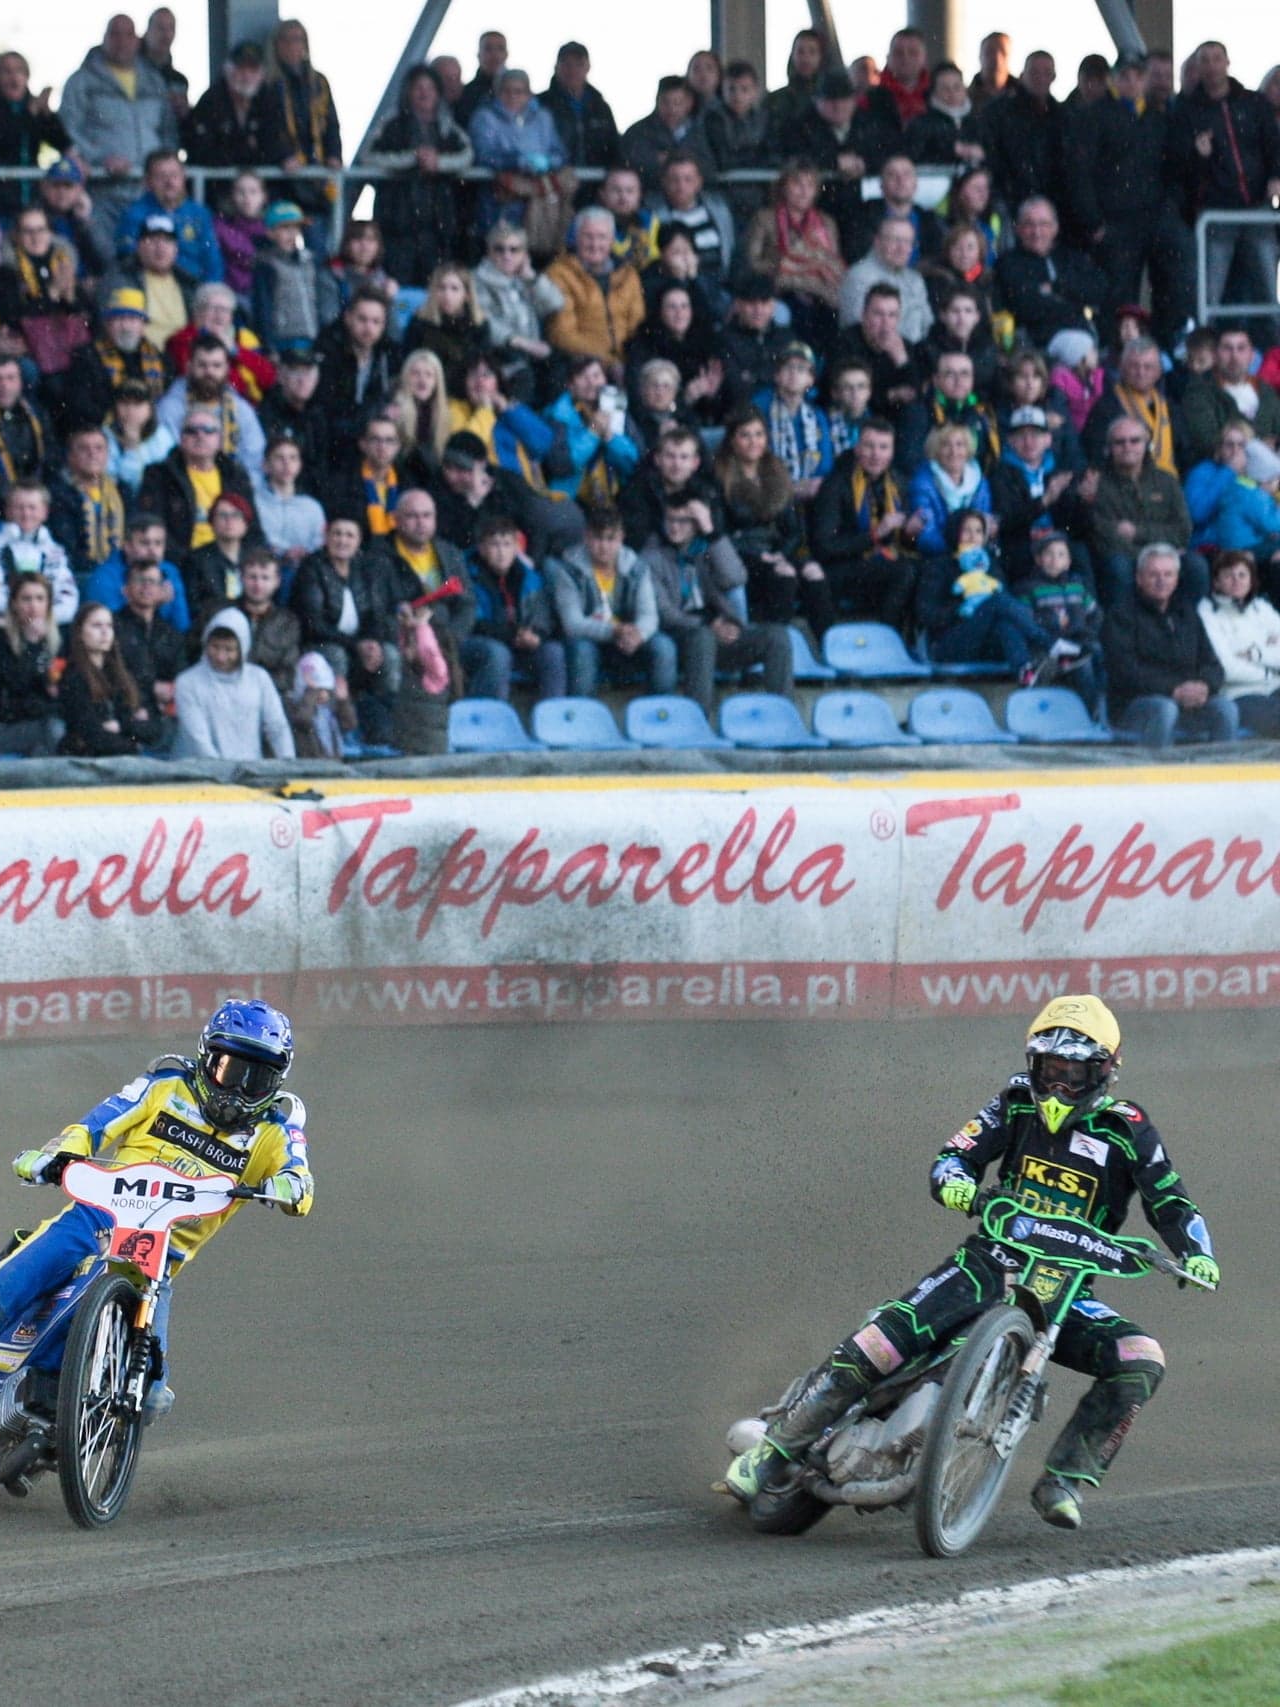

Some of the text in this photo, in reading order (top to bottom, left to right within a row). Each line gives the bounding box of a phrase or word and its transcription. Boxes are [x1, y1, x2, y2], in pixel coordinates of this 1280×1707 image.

[301, 799, 856, 941] Tapparella
[905, 793, 1280, 934] Tappar
[167, 1125, 204, 1150] CASH
[1026, 1160, 1088, 1198] K.S.
[110, 1198, 158, 1212] NORDIC
[1031, 1222, 1125, 1263] Miasto Rybnik
